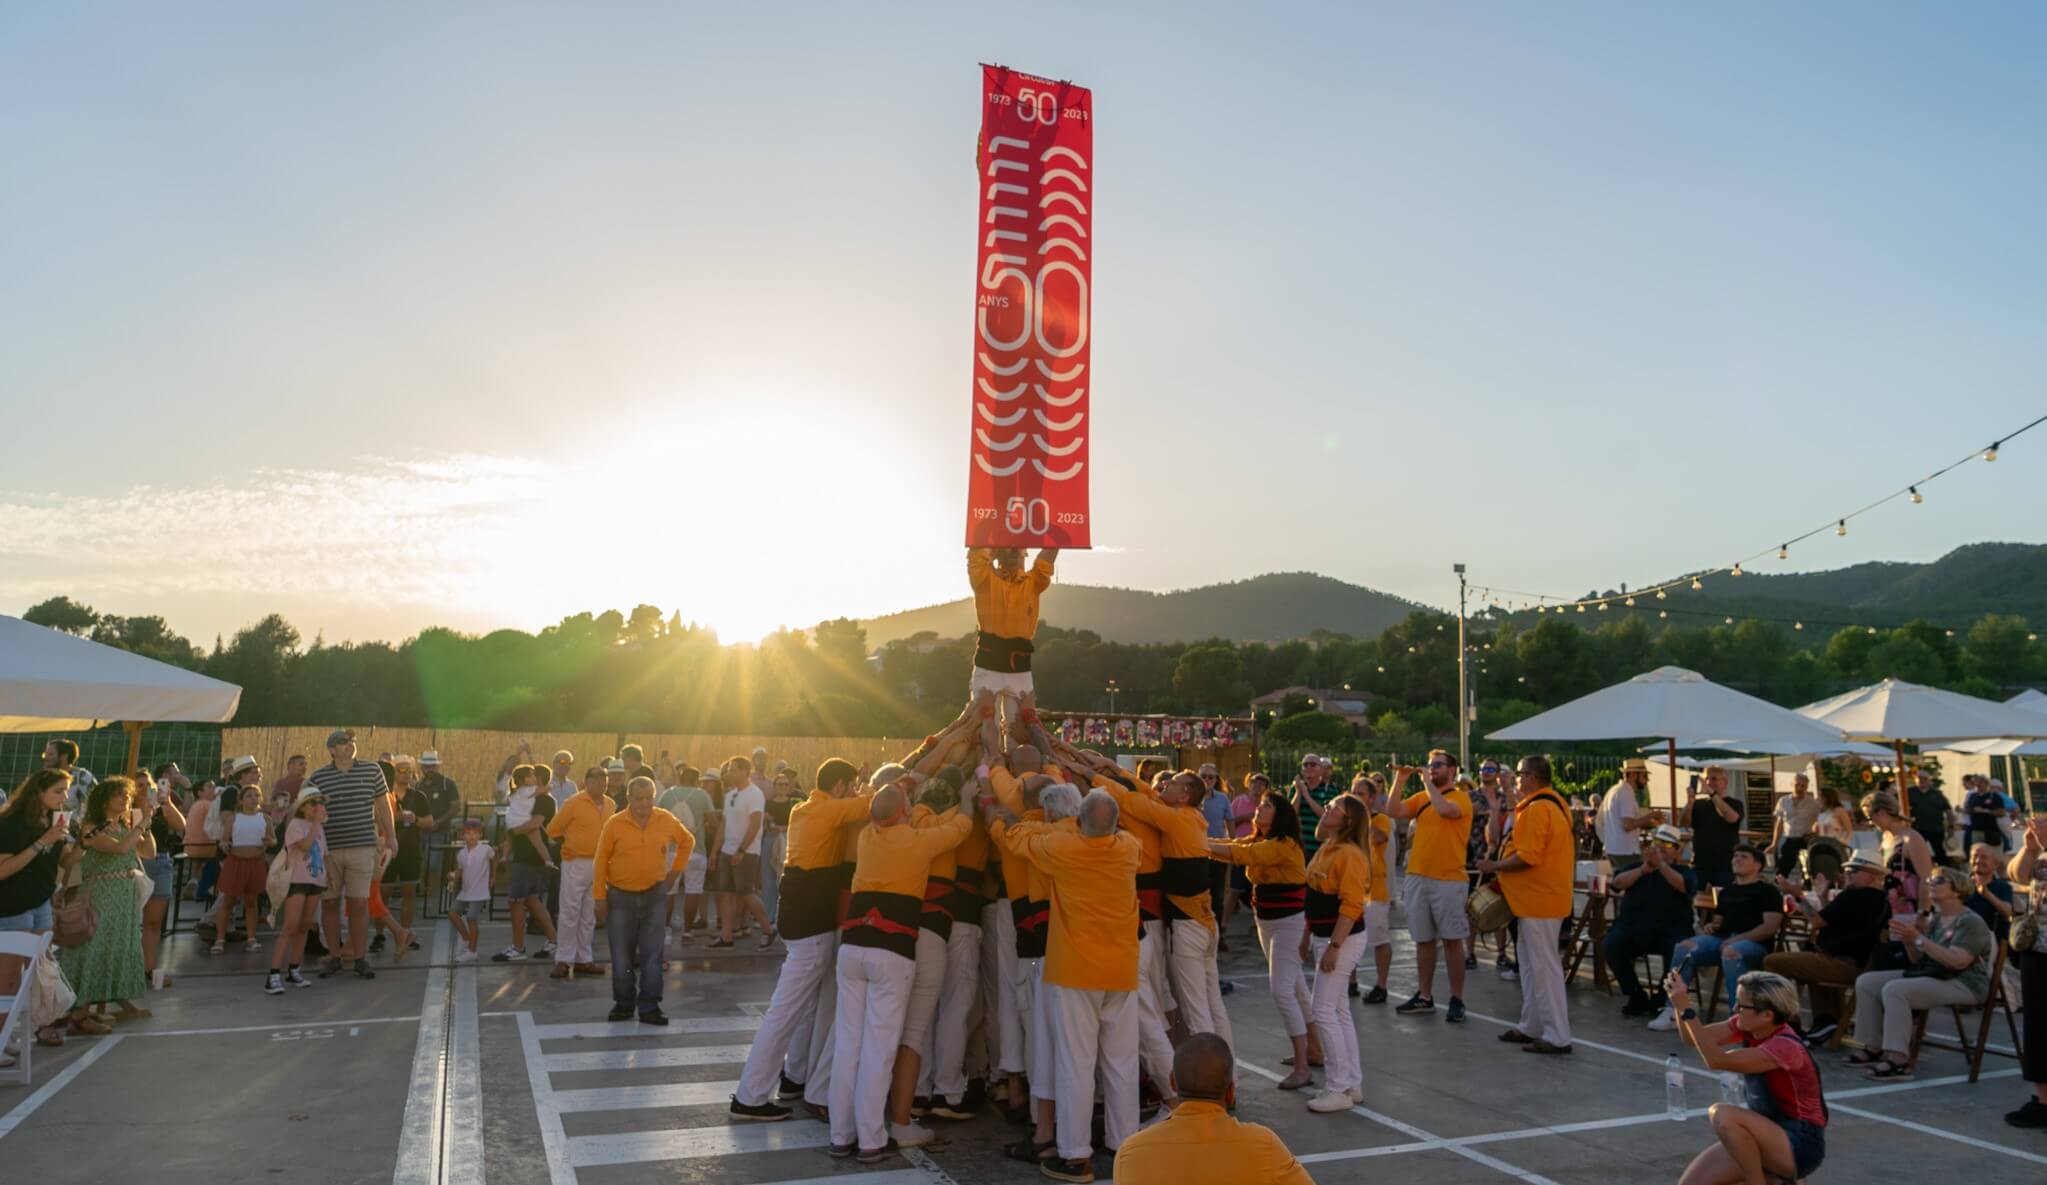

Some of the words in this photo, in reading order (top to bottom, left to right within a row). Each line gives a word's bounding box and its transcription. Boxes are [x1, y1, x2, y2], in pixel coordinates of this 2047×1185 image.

[988, 92, 1011, 106] 1973
[1017, 88, 1057, 126] 50
[978, 253, 1088, 358] 50
[979, 294, 1009, 308] ANYS
[973, 507, 998, 520] 1973
[1005, 496, 1050, 535] 50
[1057, 511, 1084, 525] 2023
